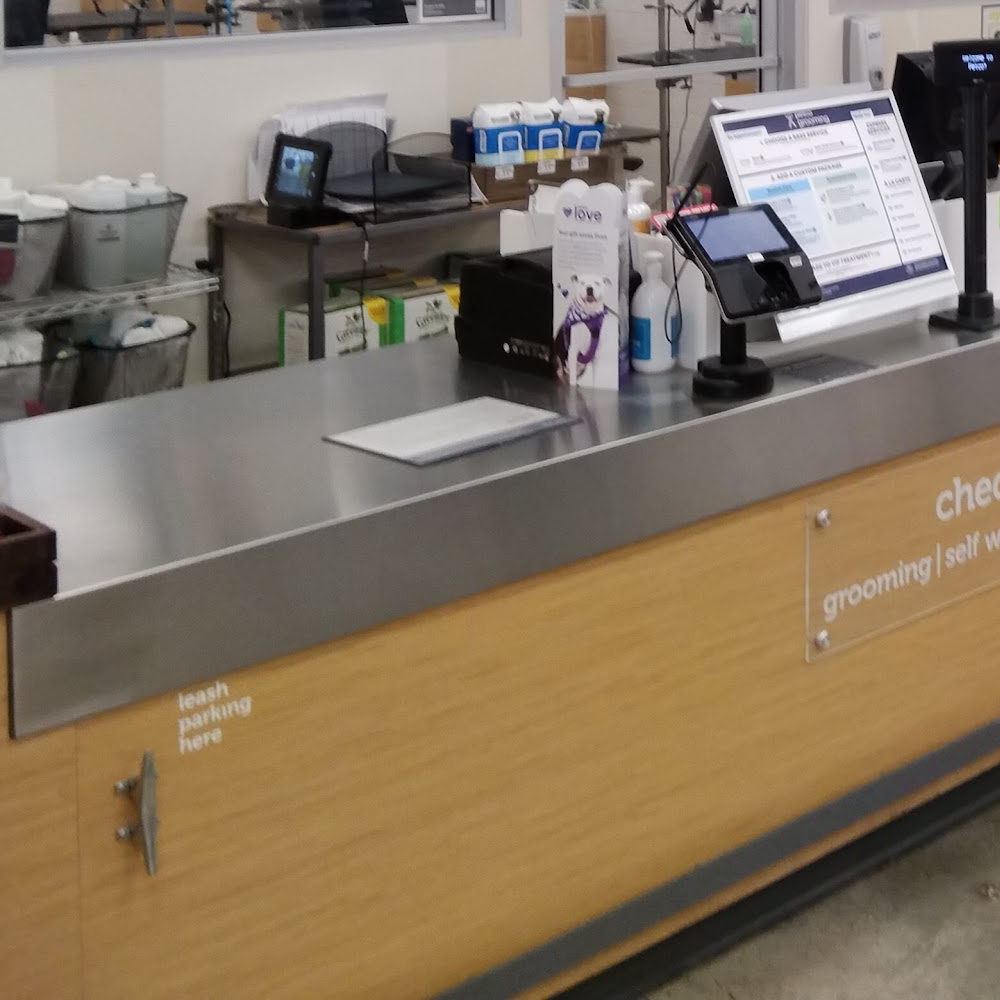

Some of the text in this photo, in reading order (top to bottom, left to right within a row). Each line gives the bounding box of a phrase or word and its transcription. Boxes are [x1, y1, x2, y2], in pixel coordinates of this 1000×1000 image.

[796, 114, 830, 129] grooming
[574, 206, 602, 222] love
[822, 553, 932, 623] grooming
[944, 530, 980, 559] self
[178, 680, 229, 712] leash
[178, 696, 252, 736] parking
[178, 727, 222, 755] here
